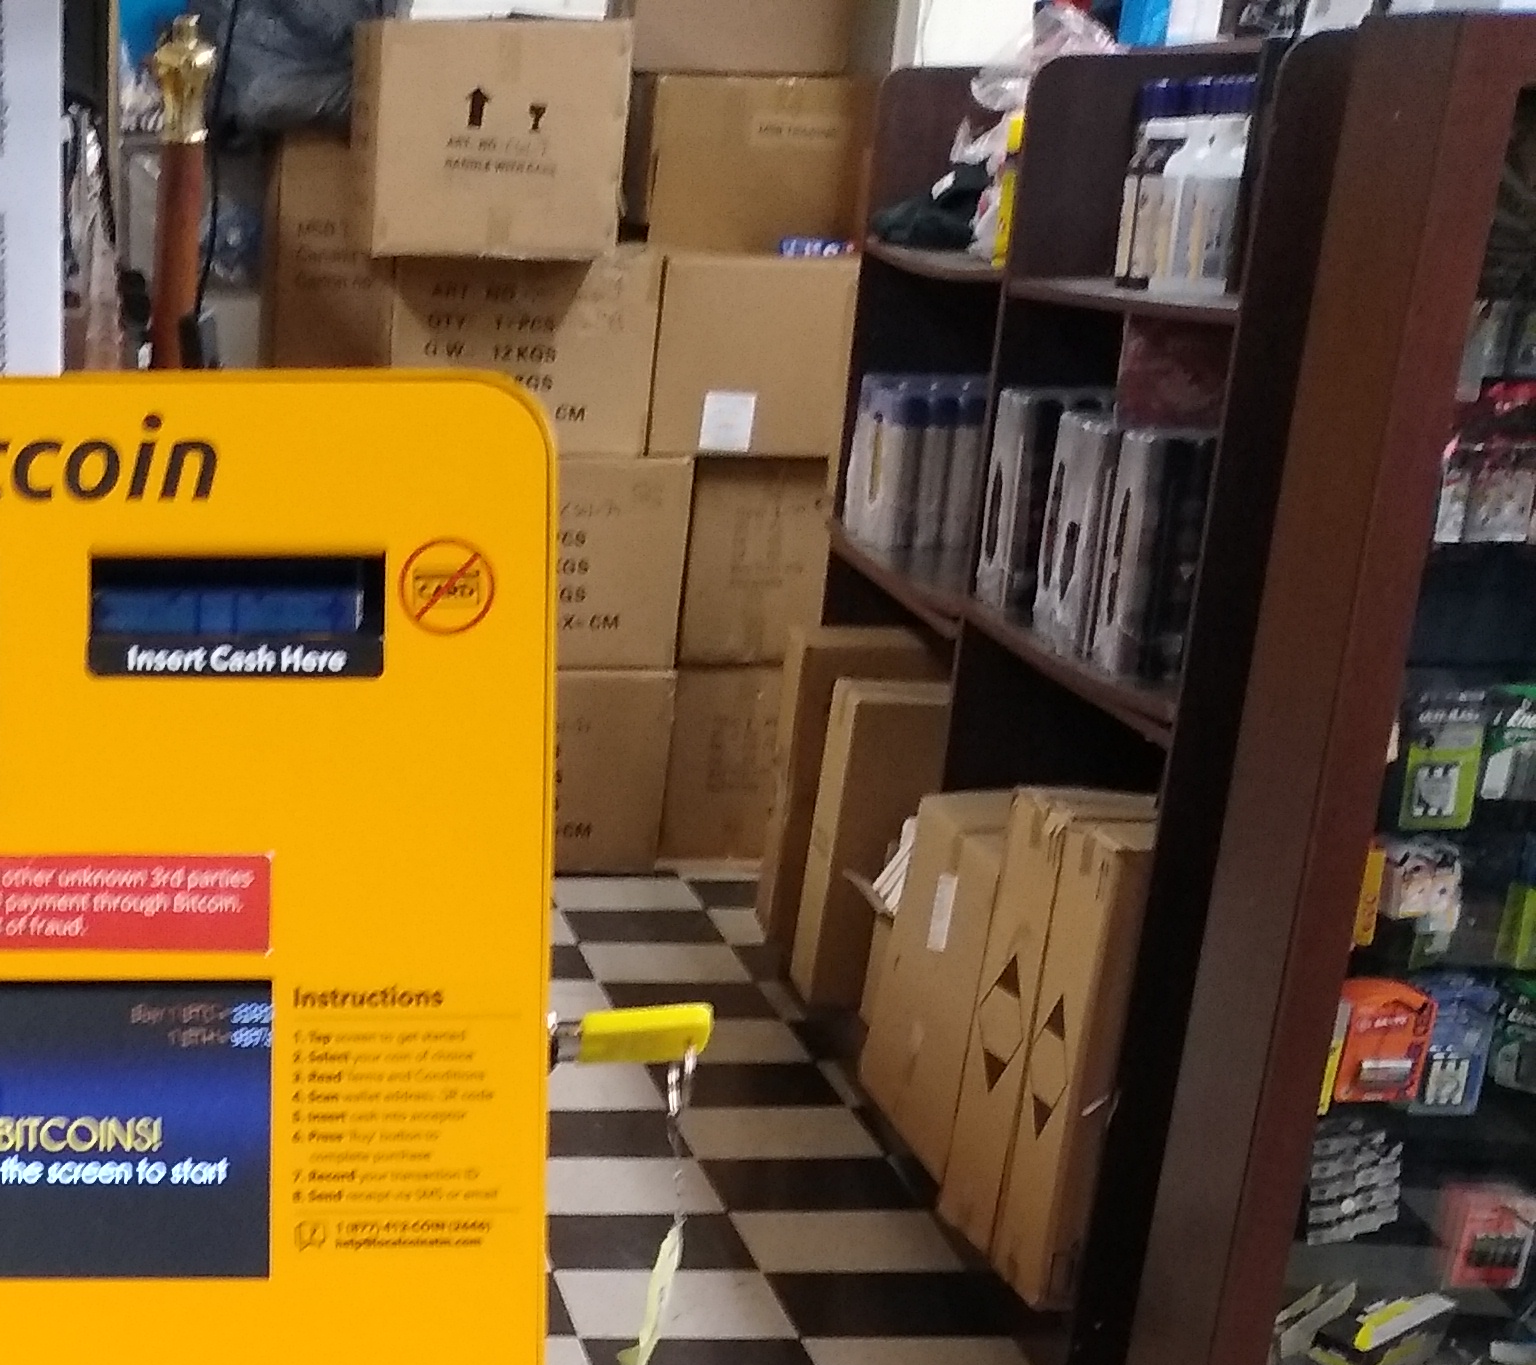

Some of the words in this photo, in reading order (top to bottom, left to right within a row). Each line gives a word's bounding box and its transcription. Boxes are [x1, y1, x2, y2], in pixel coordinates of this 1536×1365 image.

[126, 644, 207, 673] Insert
[210, 643, 274, 673] Cash
[280, 644, 348, 673] Here
[2, 866, 55, 890] other
[58, 868, 148, 891] unknown
[150, 867, 184, 889] 3rd
[186, 868, 255, 894] parties
[5, 894, 90, 919] payment
[92, 893, 170, 918] through
[4, 917, 26, 938] of
[27, 917, 88, 938] fraud.
[292, 985, 445, 1009] Instructions
[0, 1154, 44, 1186] the
[46, 1158, 133, 1187] screen
[136, 1157, 166, 1187] to
[170, 1156, 229, 1187] start
